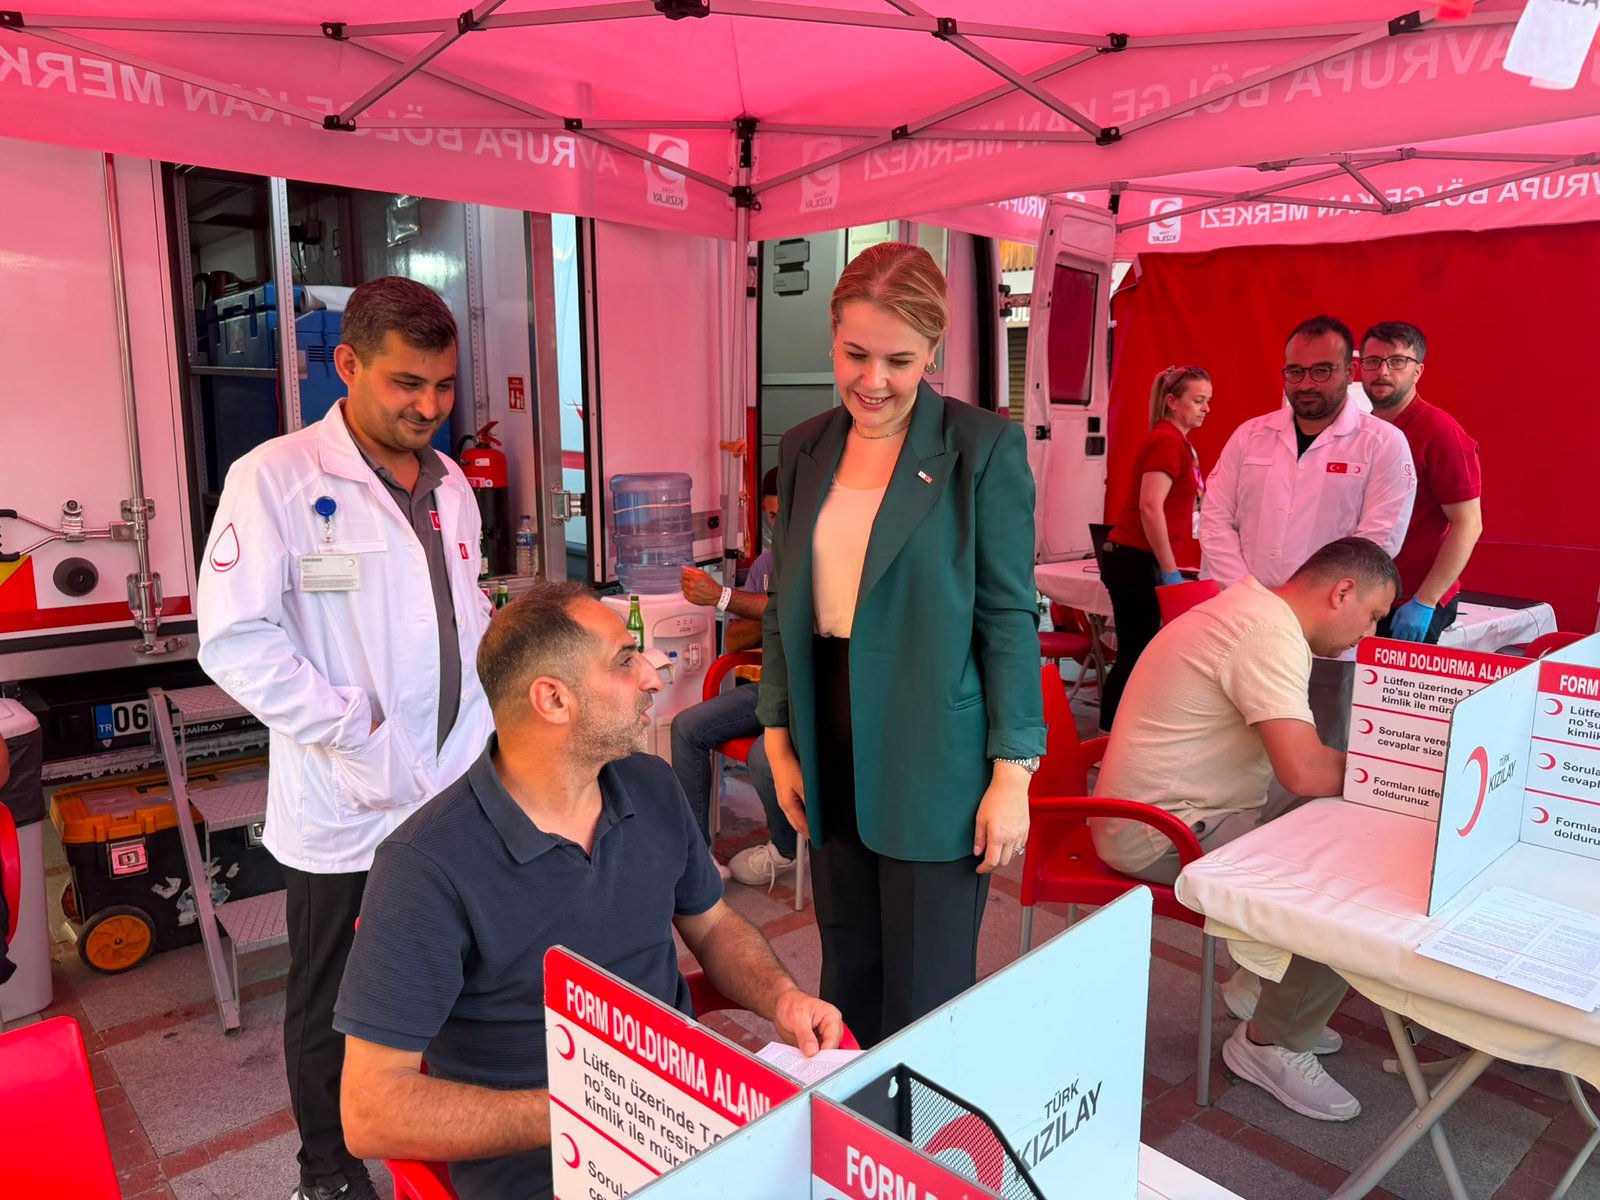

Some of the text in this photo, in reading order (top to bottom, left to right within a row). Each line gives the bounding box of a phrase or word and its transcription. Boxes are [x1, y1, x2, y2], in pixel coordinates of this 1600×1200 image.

[1374, 647, 1516, 680] FORM DOLDURMA ALAN
[1384, 675, 1415, 688] Lütfen
[1419, 682, 1464, 696] üzerinde
[1413, 691, 1435, 701] olan
[1438, 696, 1459, 705] resi
[1560, 674, 1600, 697] FORM
[1382, 695, 1411, 707] kimlik
[1414, 700, 1426, 710] ile
[99, 723, 112, 733] TR
[114, 703, 149, 733] 06
[1377, 738, 1443, 757] cevaplar size
[1379, 726, 1421, 742] Sorulara
[1499, 752, 1510, 766] TÜRK
[1373, 776, 1416, 793] Formları
[1488, 760, 1517, 794] KIZILAY
[1372, 788, 1430, 807] doldurunuz
[565, 978, 609, 1036] FORM
[612, 1008, 710, 1098] DOLDURMA
[583, 1047, 626, 1089] Lütfen
[630, 1078, 695, 1134] üzerinde
[1044, 1078, 1079, 1120] TÜRK
[584, 1091, 684, 1167] kimlik ile mür
[625, 1101, 656, 1131] olan
[1015, 1080, 1102, 1175] KIZILAY
[846, 1144, 917, 1200] FORM
